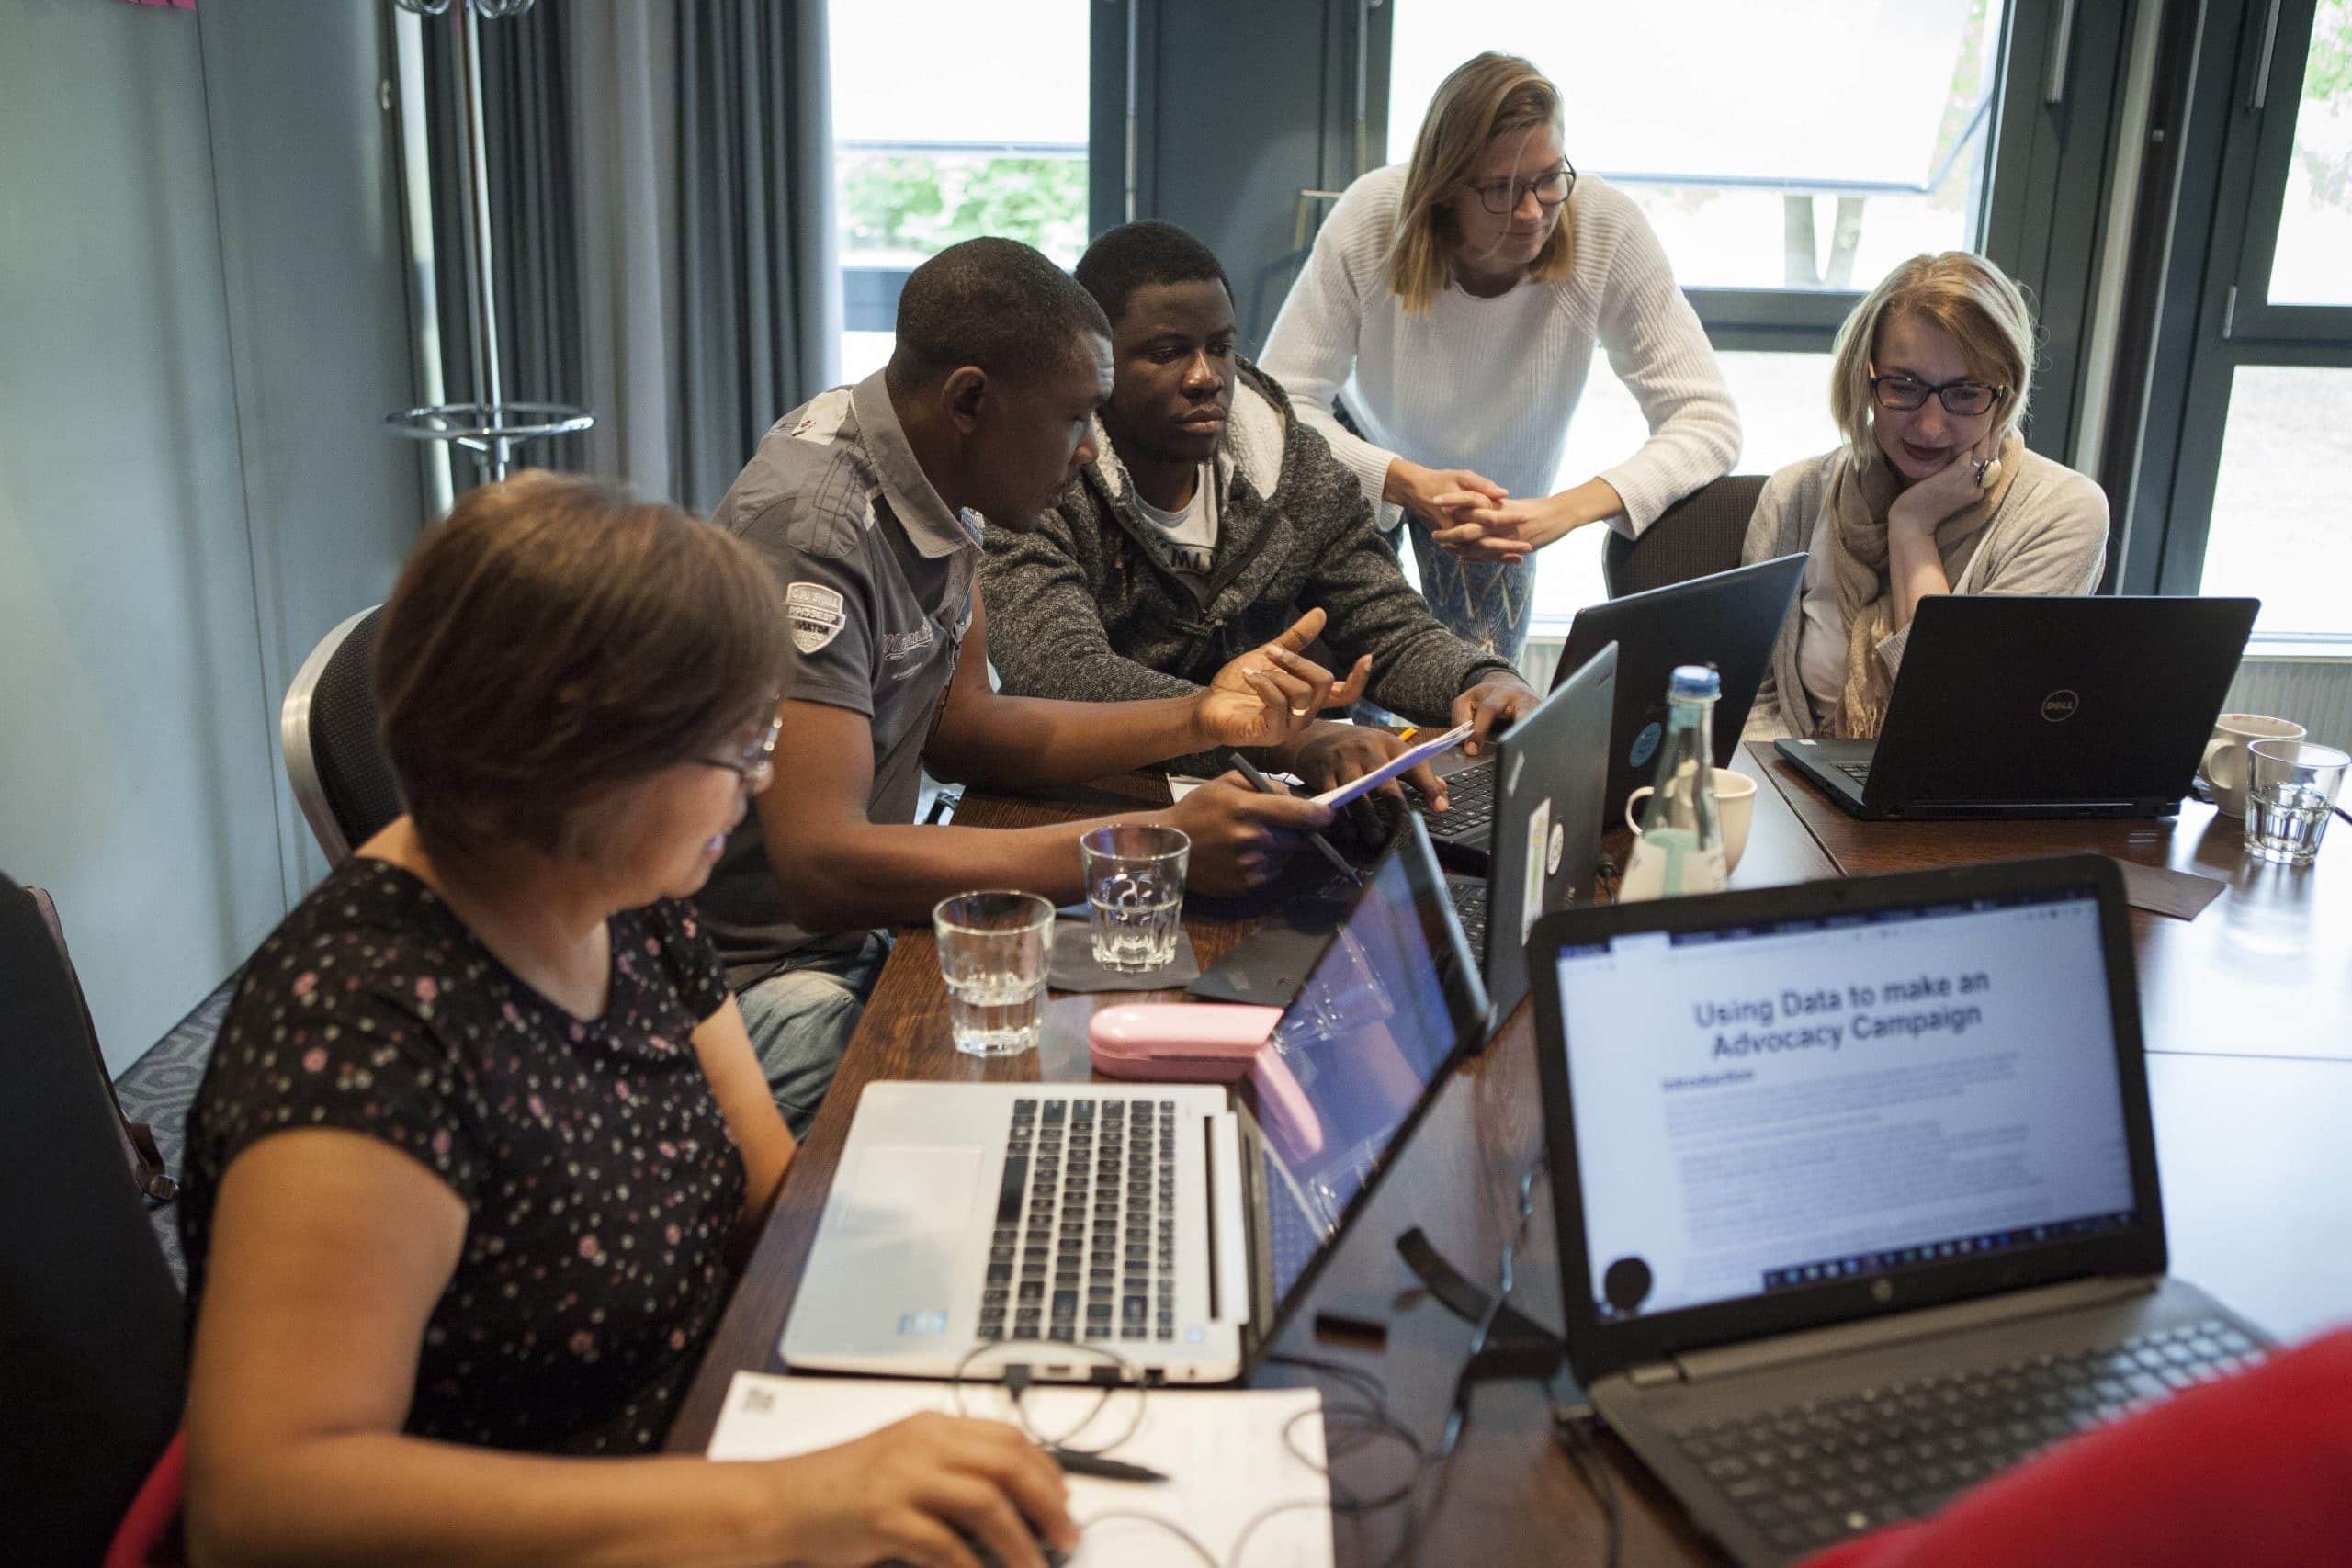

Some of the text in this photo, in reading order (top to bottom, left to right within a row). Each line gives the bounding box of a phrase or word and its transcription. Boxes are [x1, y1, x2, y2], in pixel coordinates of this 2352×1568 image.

[2046, 701, 2074, 710] DELL
[1694, 972, 1990, 1028] Using Data to make an
[1713, 1005, 1983, 1059] Advocacy Campaign
